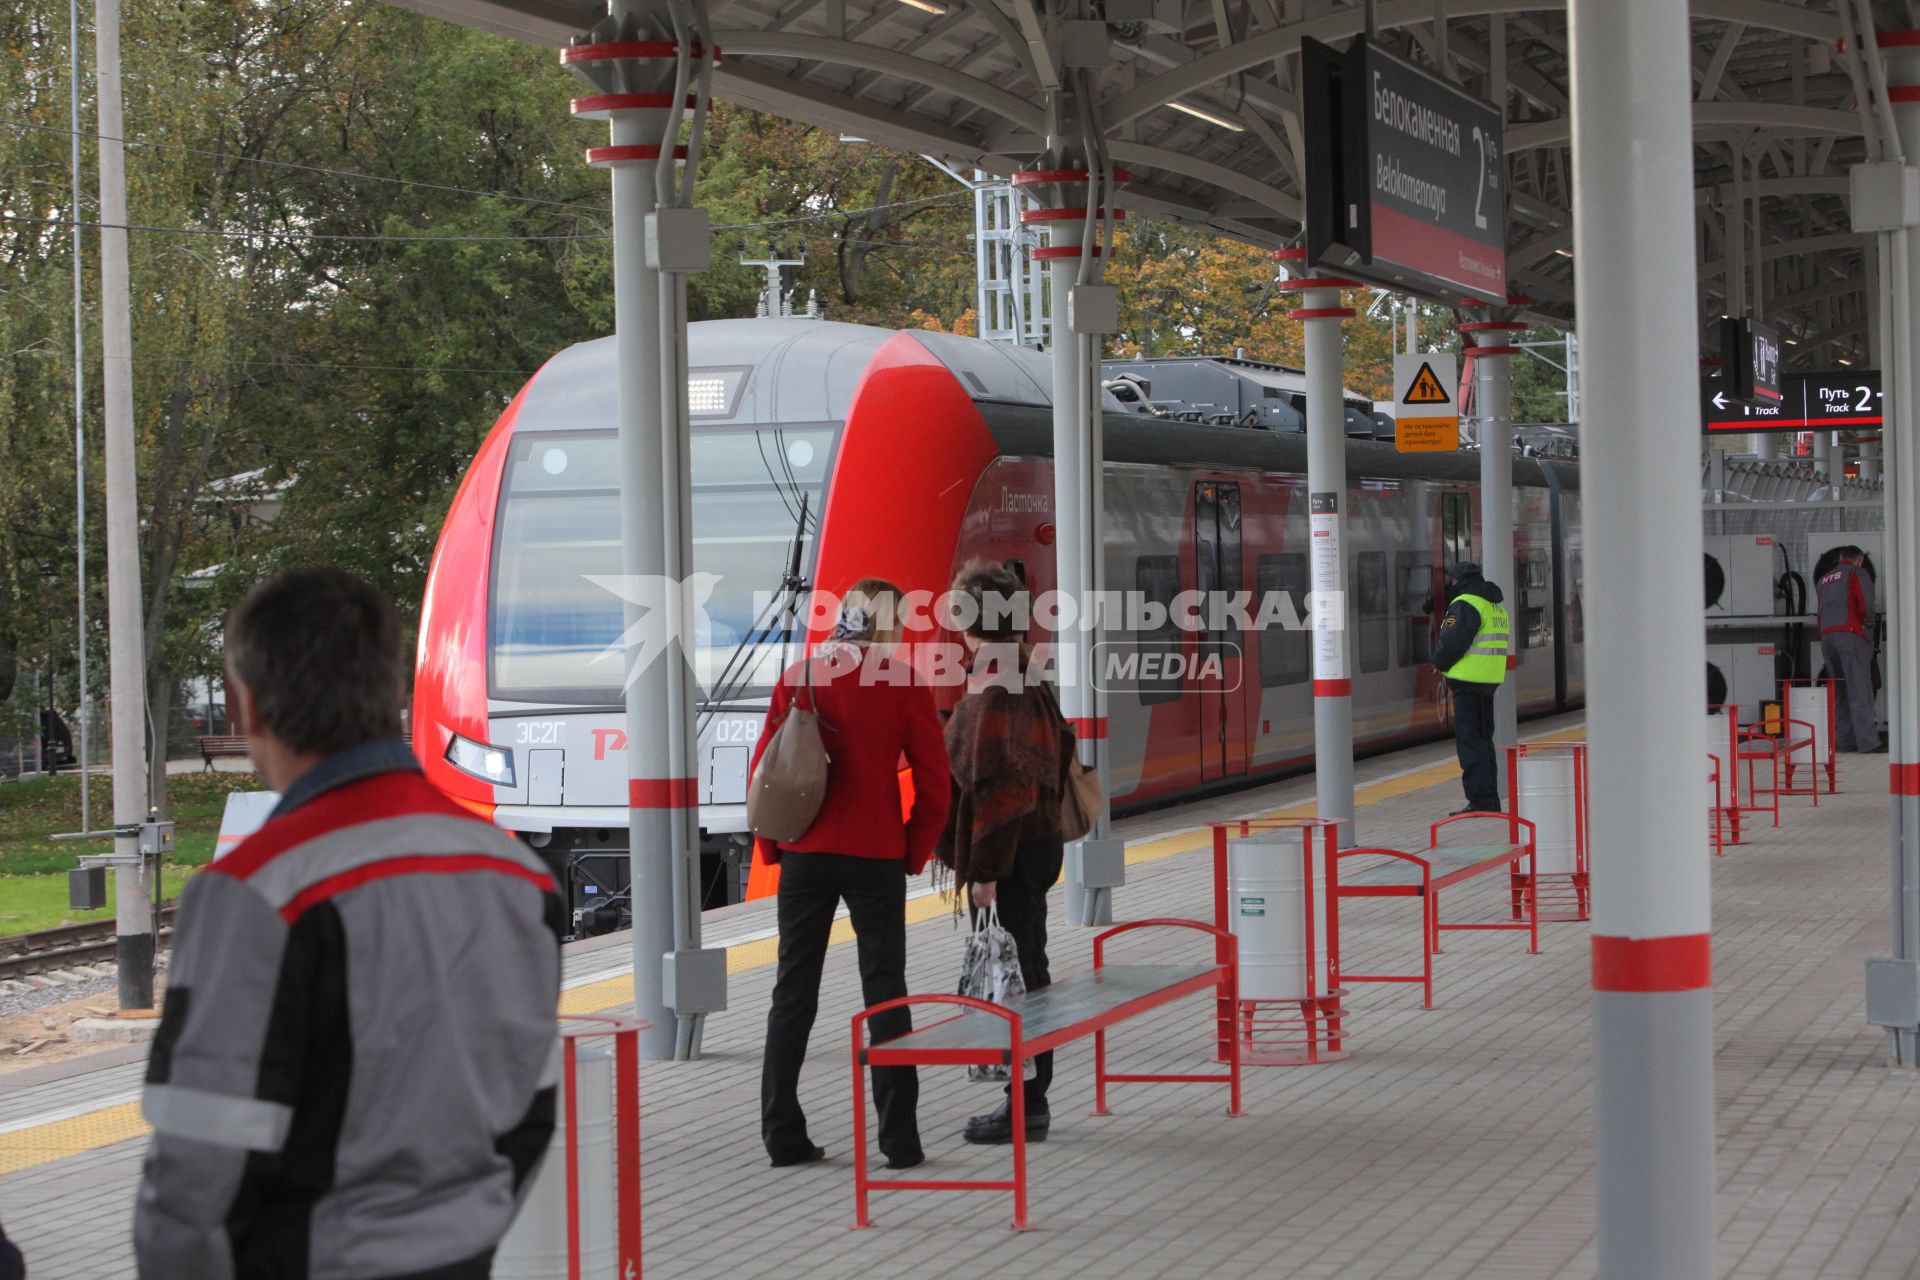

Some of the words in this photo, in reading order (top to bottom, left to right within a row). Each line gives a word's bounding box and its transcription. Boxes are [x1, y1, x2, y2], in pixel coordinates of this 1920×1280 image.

[1374, 70, 1460, 157] Белокаменная
[1377, 153, 1446, 221] Belokamennaya
[1472, 126, 1487, 229] 2
[1819, 387, 1850, 401] Путь
[1855, 385, 1872, 411] 2
[1825, 402, 1849, 412] Track
[1755, 406, 1779, 415] Track
[1001, 486, 1048, 513] Ласточка
[1329, 498, 1334, 508] 1
[516, 721, 566, 744] ЭС2Г
[716, 719, 758, 742] 028
